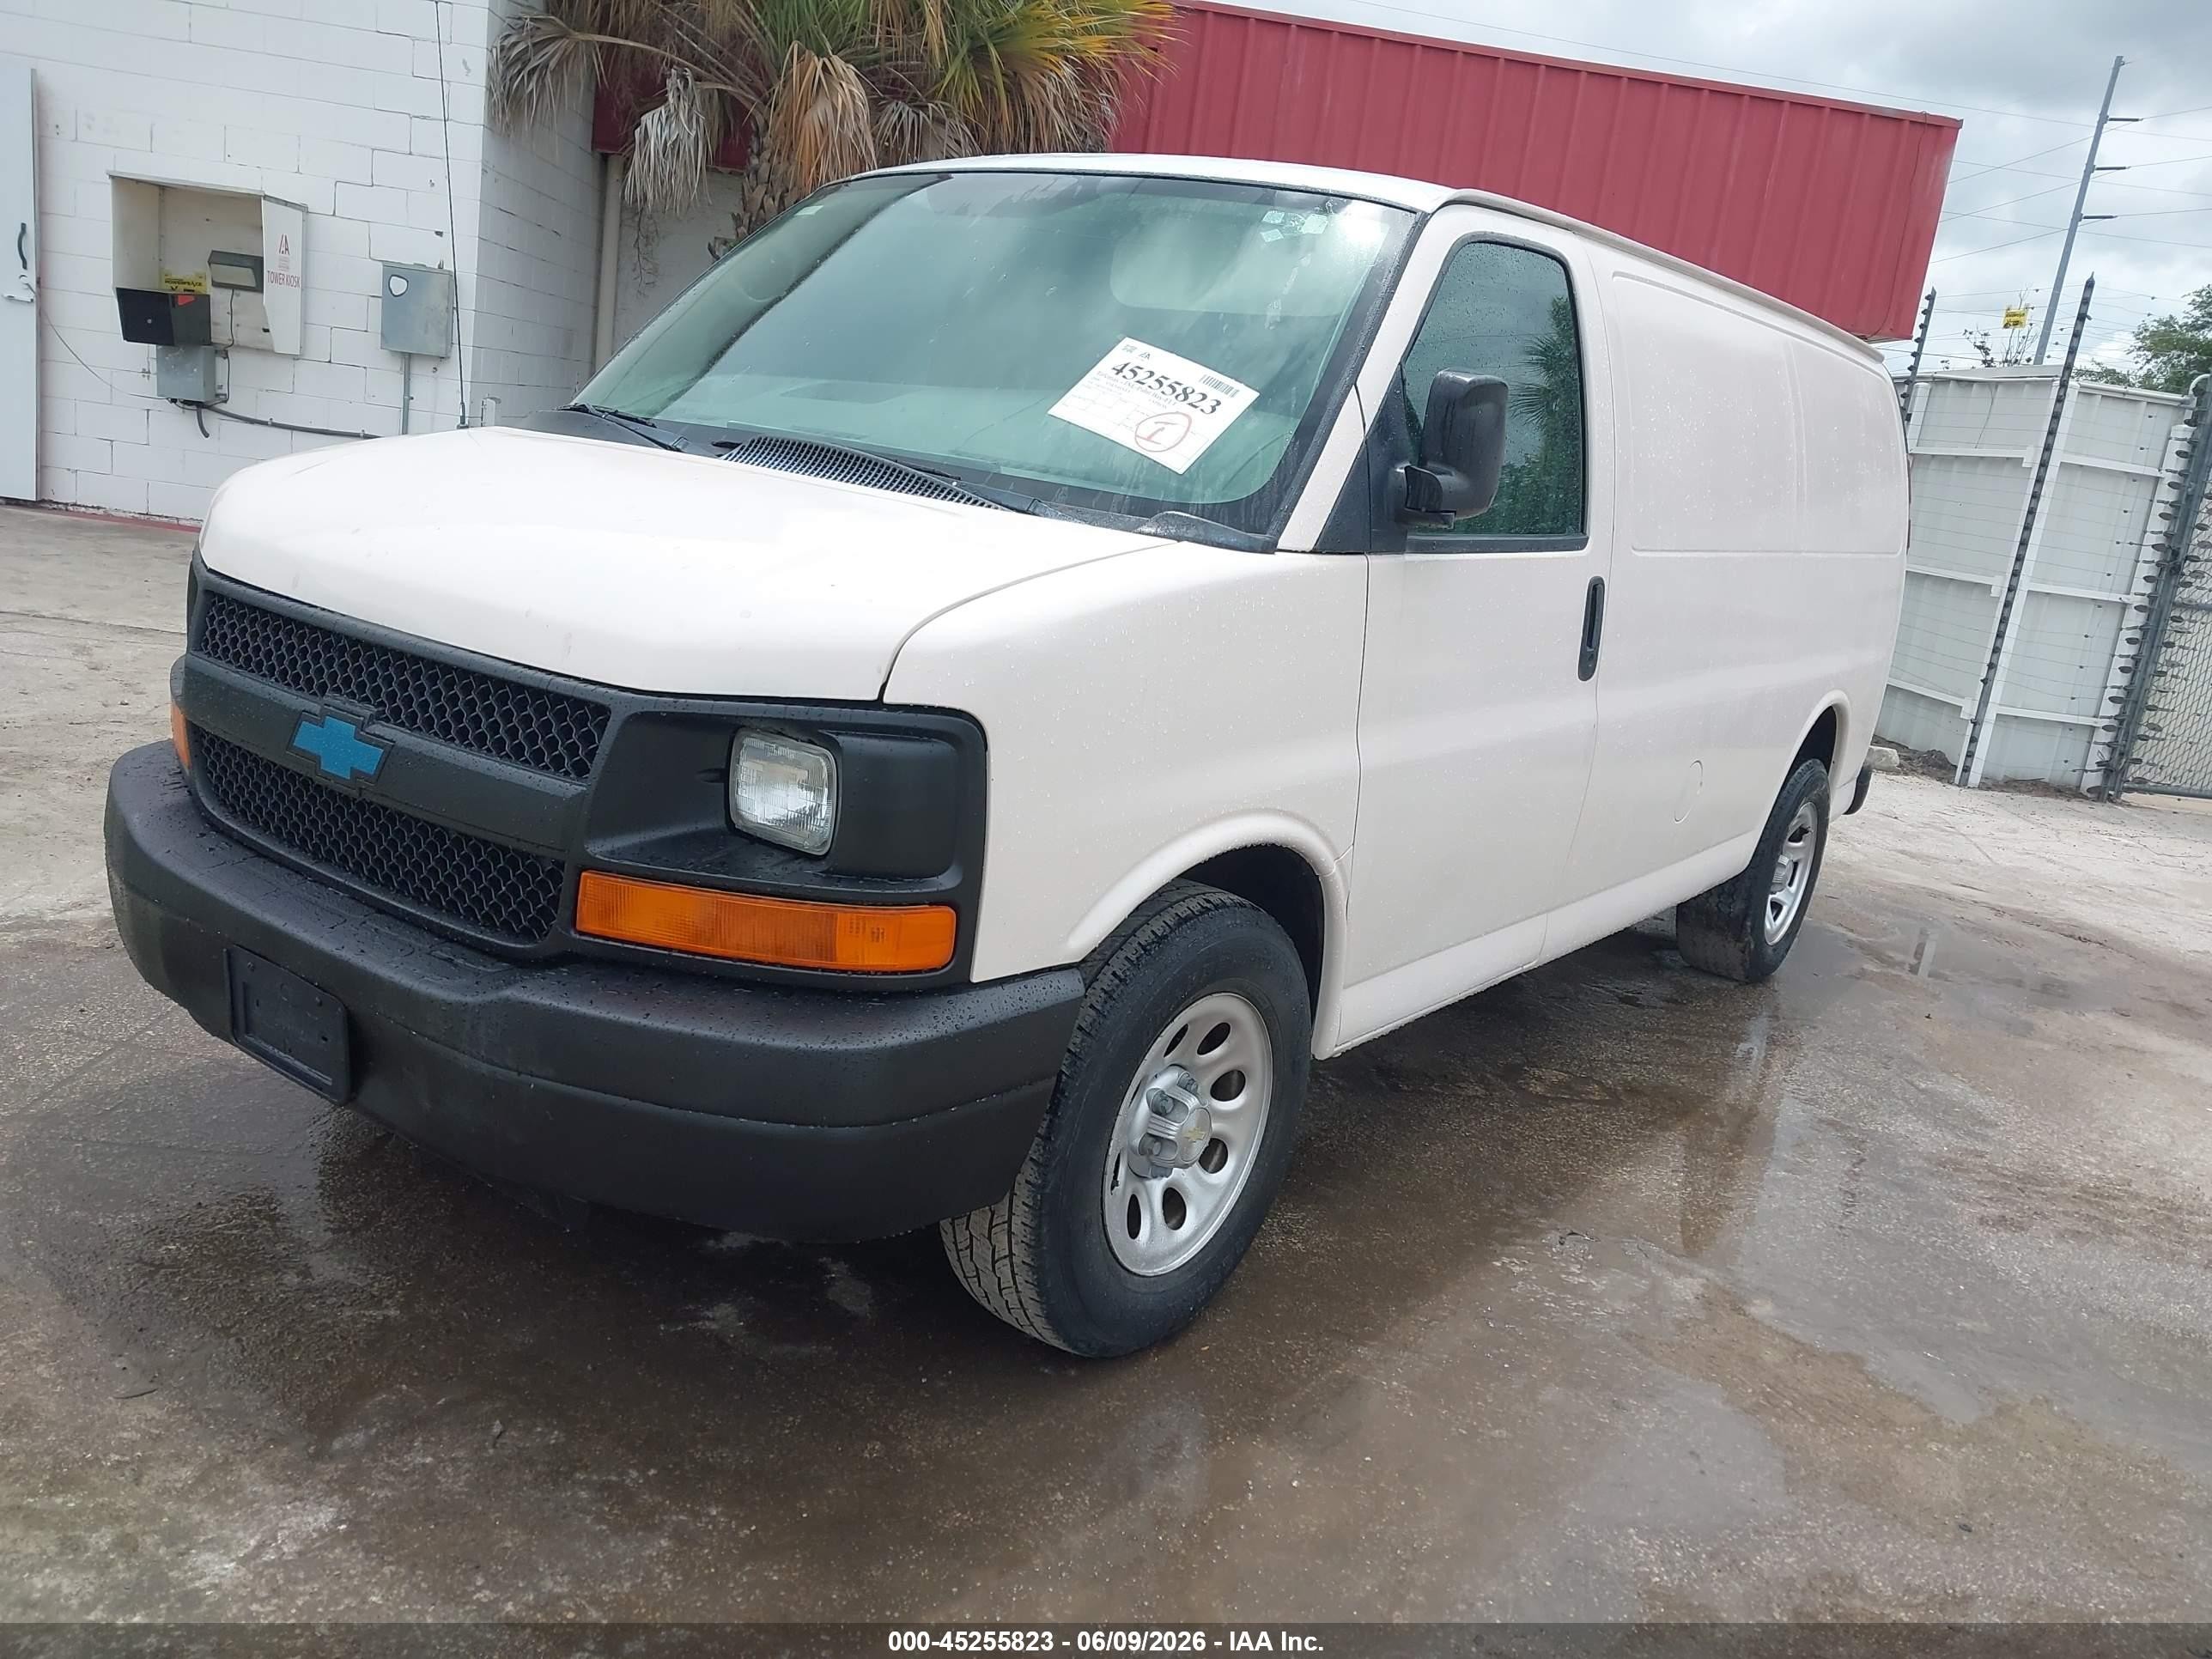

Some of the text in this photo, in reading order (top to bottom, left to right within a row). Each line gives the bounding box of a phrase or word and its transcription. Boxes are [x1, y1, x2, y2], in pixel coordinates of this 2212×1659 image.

[267, 270, 301, 289] TOWER KIOSK
[1111, 362, 1222, 415] 45255823
